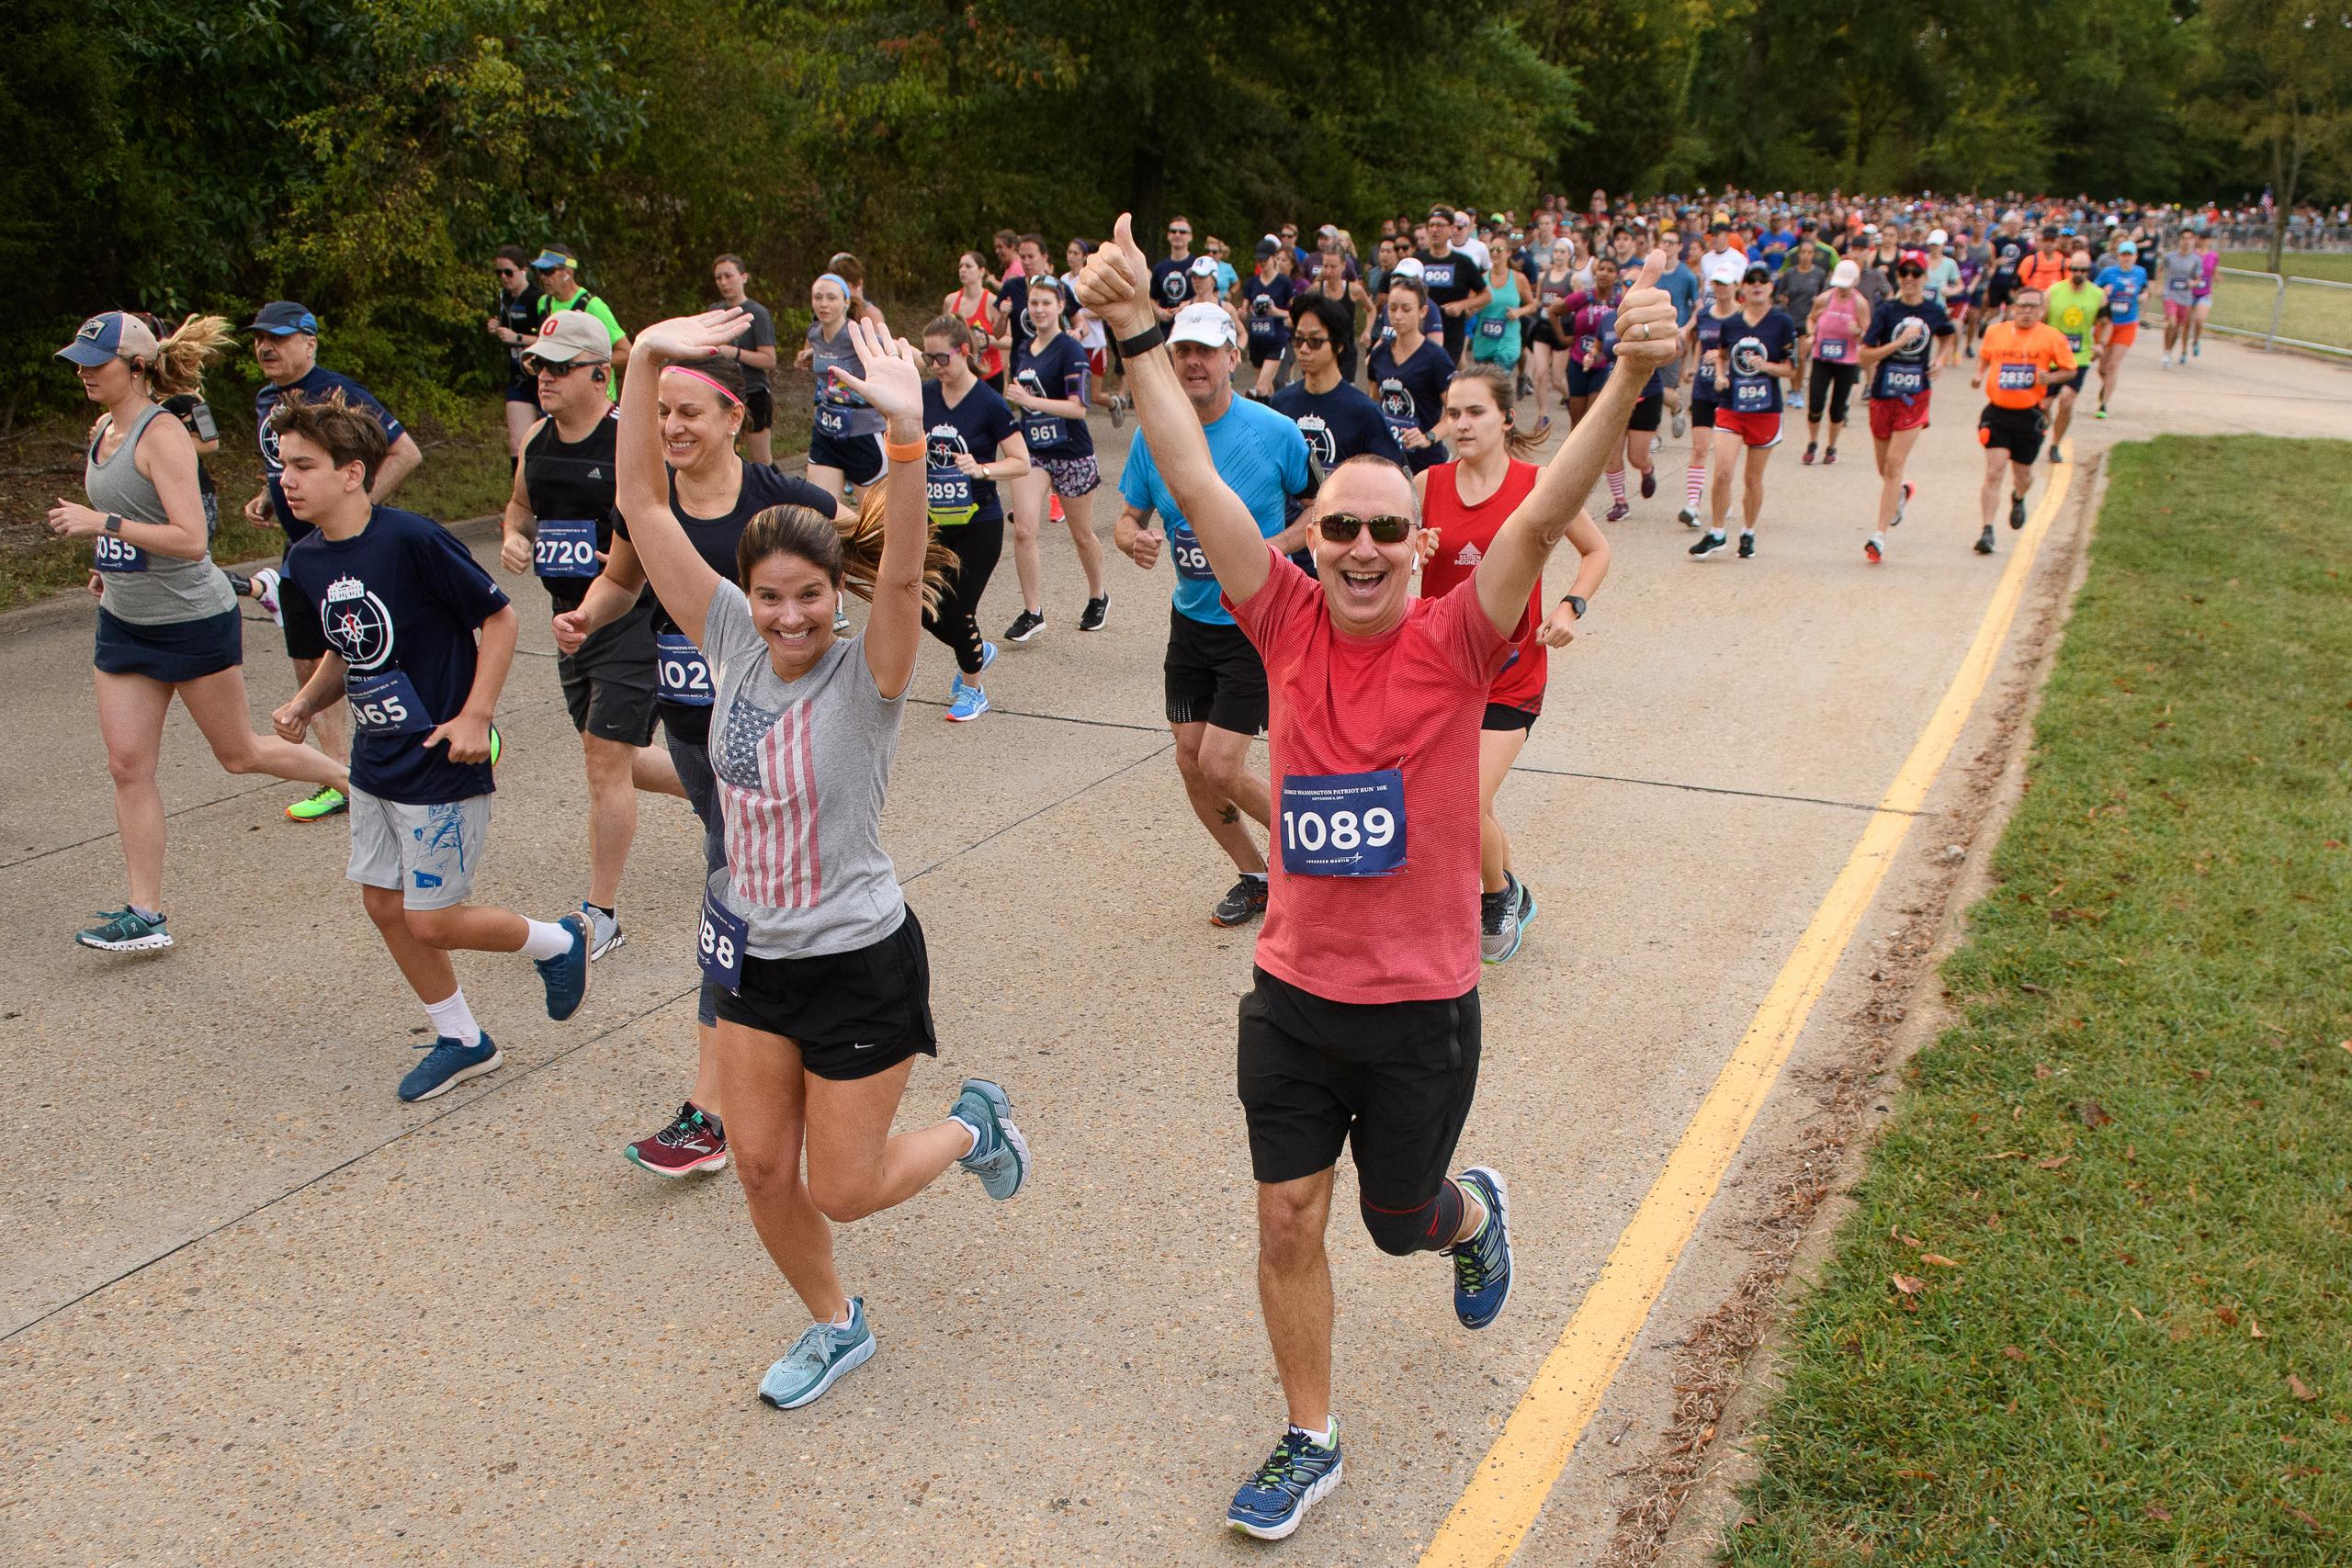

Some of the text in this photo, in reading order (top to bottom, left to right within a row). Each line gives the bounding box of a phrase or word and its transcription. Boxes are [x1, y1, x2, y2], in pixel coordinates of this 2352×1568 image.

[1888, 372, 1921, 388] 1001
[1738, 385, 1768, 399] 894
[821, 411, 842, 430] 814
[1030, 424, 1057, 441] 961
[927, 482, 968, 499] 2893
[536, 541, 594, 564] 2720
[657, 659, 709, 689] 102
[350, 695, 408, 725] 965
[1283, 807, 1395, 851] 1089
